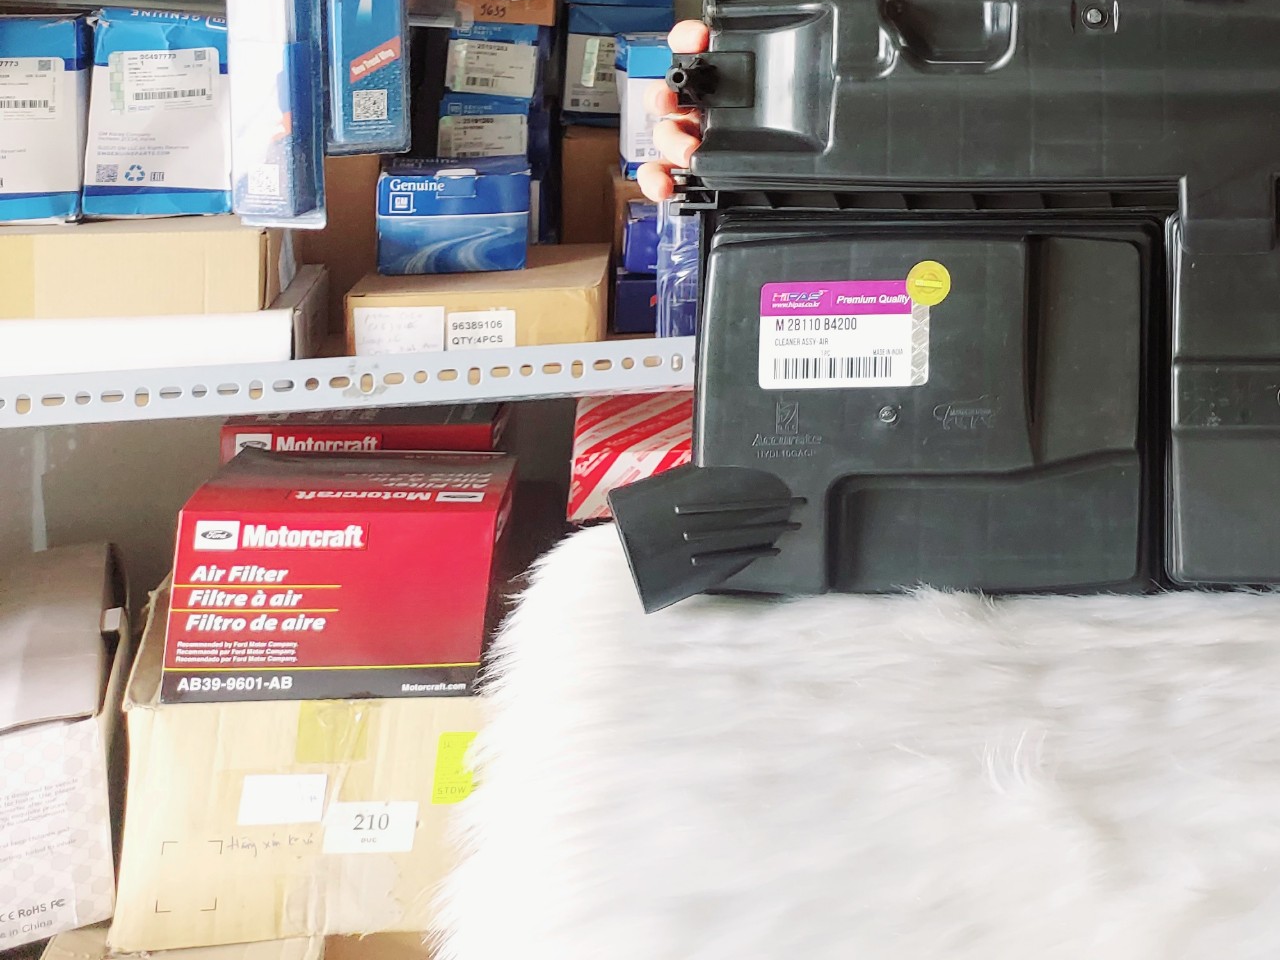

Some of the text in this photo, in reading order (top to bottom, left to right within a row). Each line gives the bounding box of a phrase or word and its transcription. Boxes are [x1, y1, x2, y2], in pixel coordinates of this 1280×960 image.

[131, 9, 201, 22] GENUINE
[389, 179, 446, 192] Genuine
[771, 301, 822, 310] www.hipas.co.kr
[836, 293, 911, 307] Premium Quality
[452, 319, 504, 331] 96389106
[775, 317, 821, 332] M 28110
[451, 333, 504, 346] QTY:4PCS
[774, 338, 800, 347] CLEANER
[294, 489, 431, 501] Motorcraft
[204, 523, 365, 549] Ford Motorcraft
[190, 565, 289, 583] Air Filter
[187, 589, 302, 608] Filtre à air
[184, 614, 327, 633] Filtro de aire
[177, 641, 298, 649] Recommended Company.
[176, 675, 294, 693] AB39-9601-AB
[401, 682, 467, 693] Motorcraft.com
[352, 813, 391, 832] 210
[18, 902, 47, 919] RoHS
[22, 917, 54, 934] China
